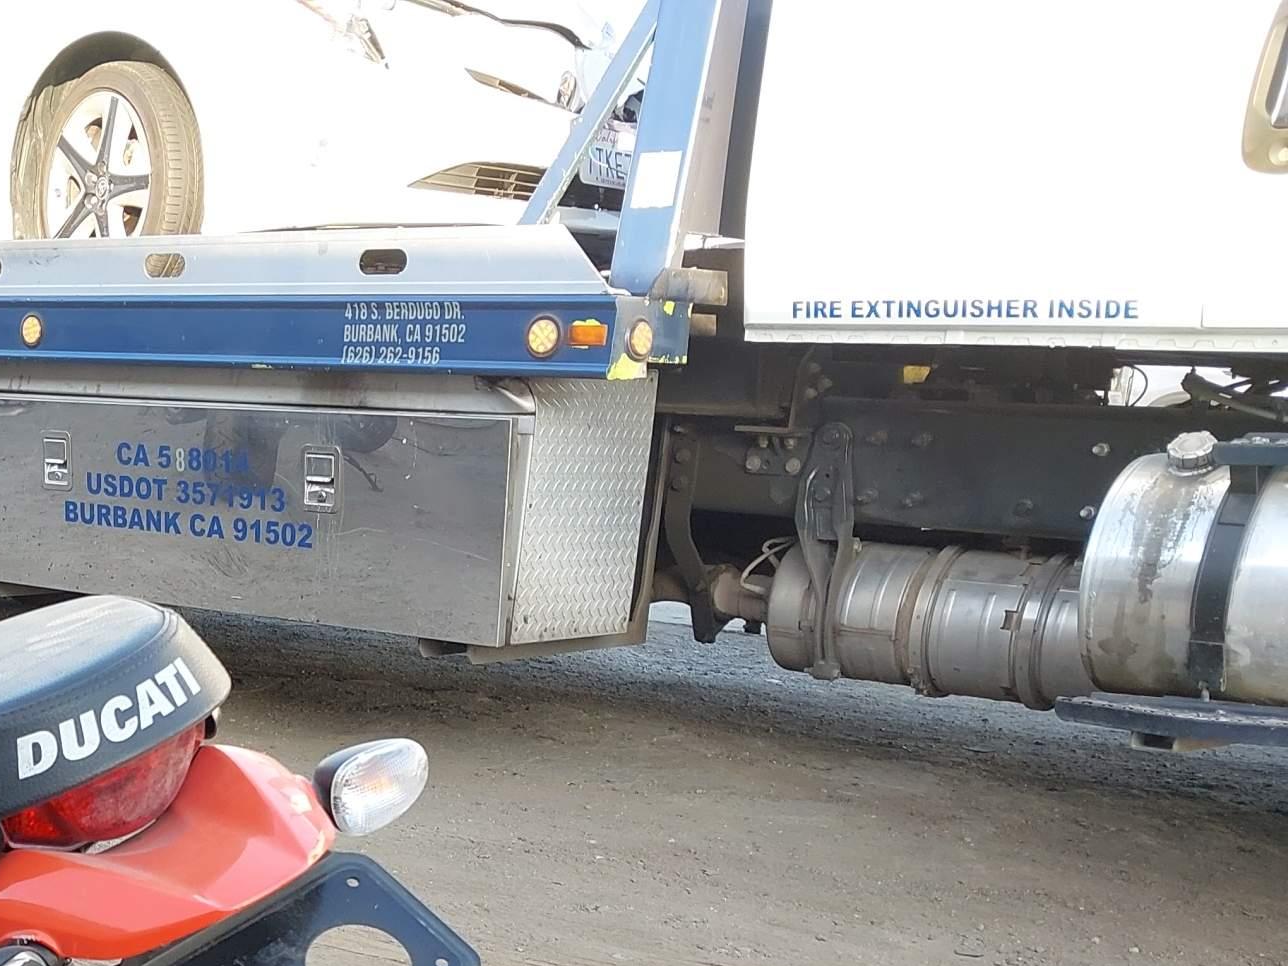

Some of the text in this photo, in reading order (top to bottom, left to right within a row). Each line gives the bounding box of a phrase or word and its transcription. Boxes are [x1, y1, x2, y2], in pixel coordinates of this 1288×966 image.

[344, 301, 465, 320] 418 S. BERDUGO DR.
[791, 300, 1139, 319] FIRE EXTINGUISHER INSIDE
[343, 324, 466, 344] BURBANK, CA 91502
[341, 345, 441, 365] (626) 262-9156
[116, 442, 250, 472] CA 588014
[86, 471, 286, 513] USDOT 3571913
[64, 500, 312, 549] BURBANK CA 91502
[16, 656, 201, 780] DUCATI
